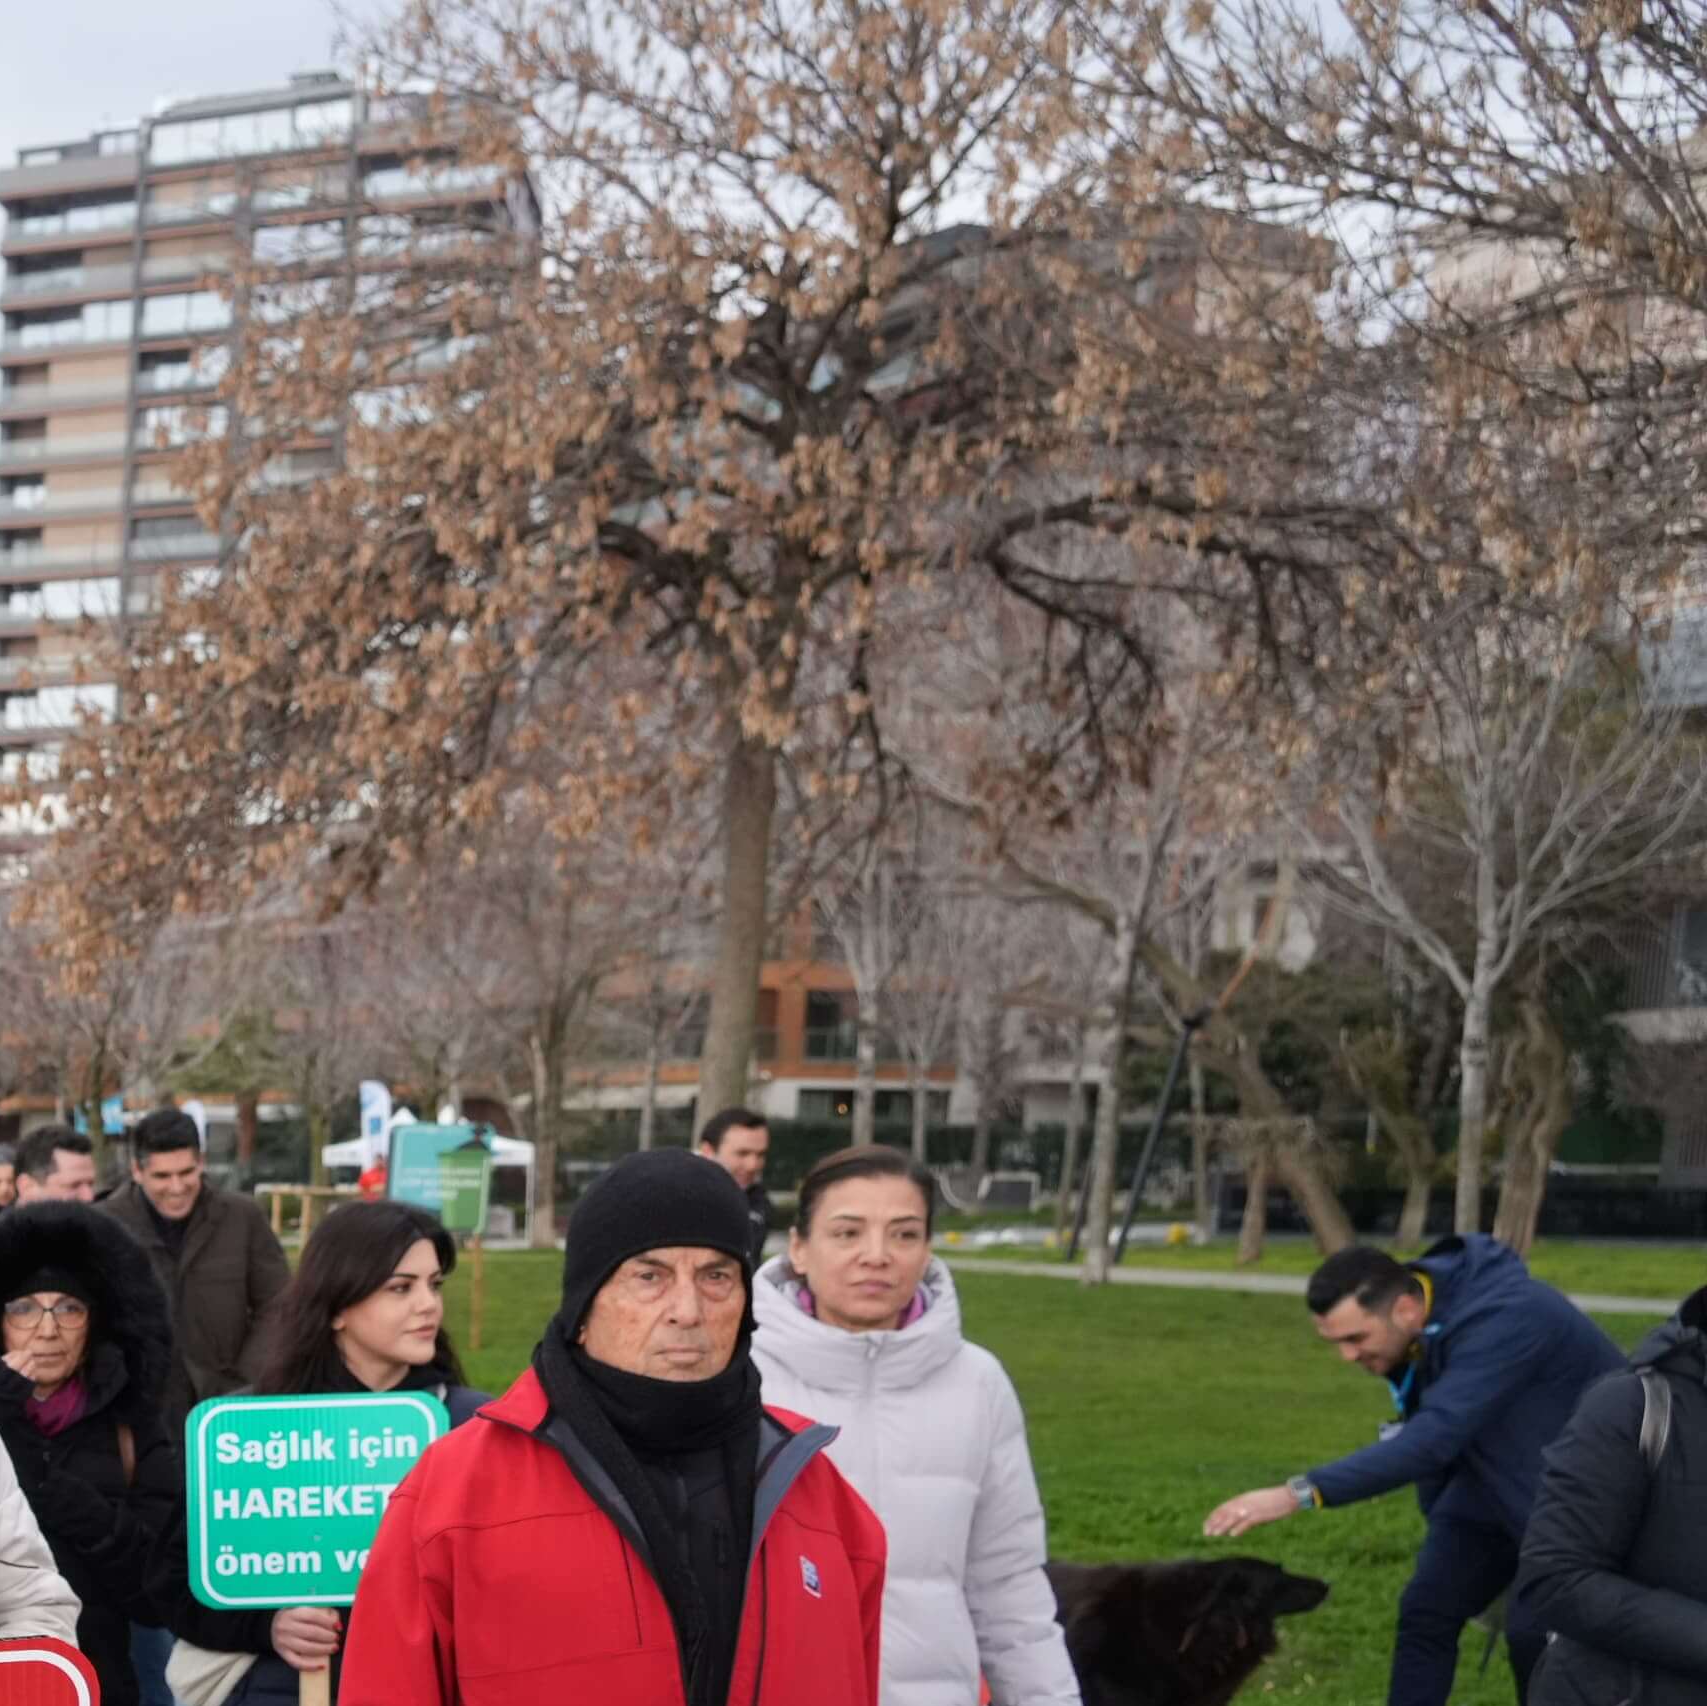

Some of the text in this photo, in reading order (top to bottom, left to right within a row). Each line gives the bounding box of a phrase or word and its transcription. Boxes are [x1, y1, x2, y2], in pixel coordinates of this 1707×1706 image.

[215, 1427, 418, 1469] Sağlık için
[213, 1483, 398, 1519] HAREKET
[215, 1545, 322, 1576] önem
